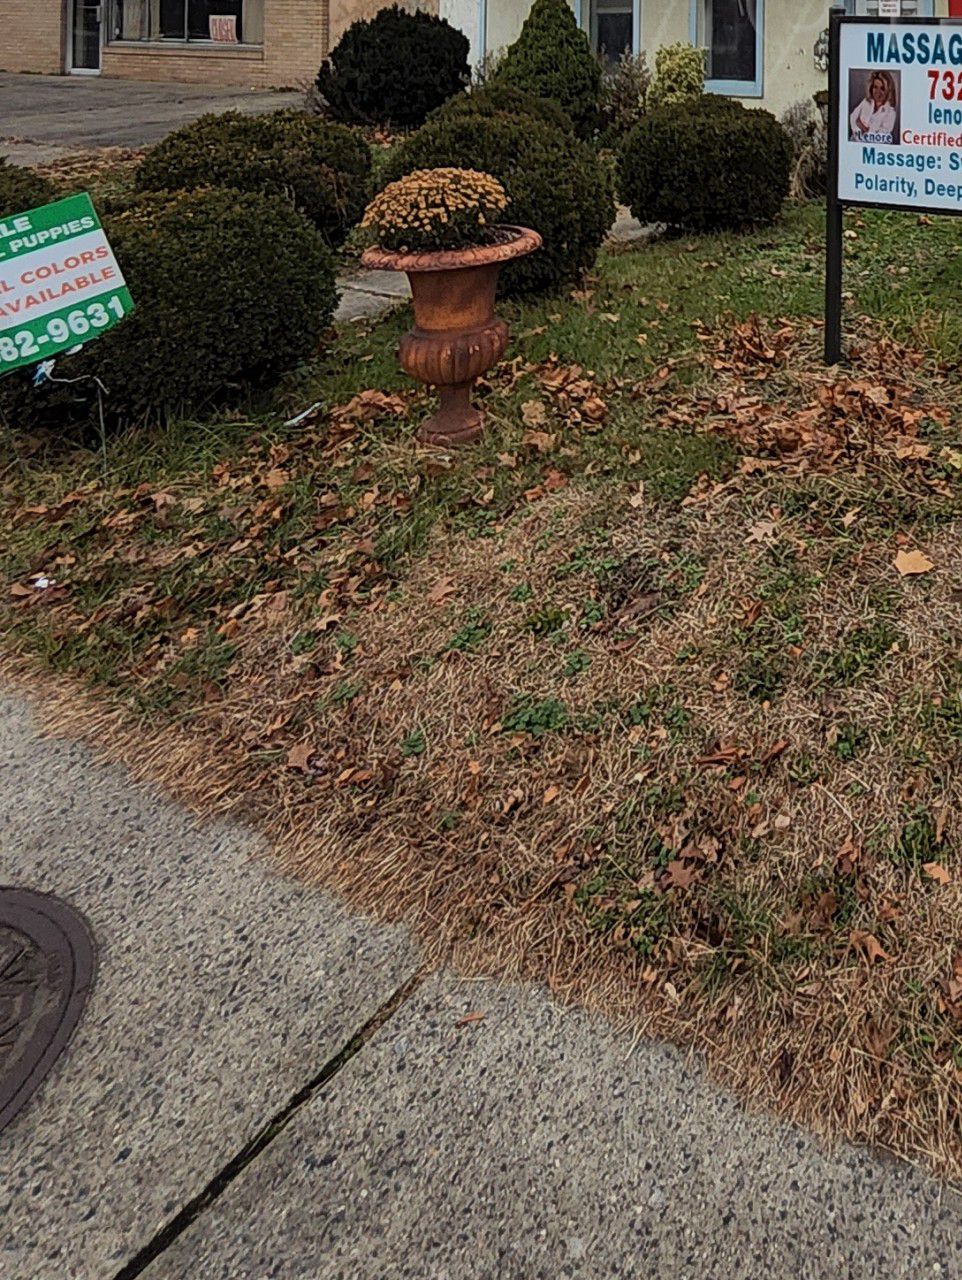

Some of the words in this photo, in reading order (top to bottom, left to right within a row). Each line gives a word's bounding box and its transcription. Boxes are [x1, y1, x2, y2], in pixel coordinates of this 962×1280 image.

[857, 129, 893, 143] Lenore
[862, 147, 942, 172] Massage:
[854, 173, 917, 197] Polarity,
[0, 216, 33, 238] LE
[9, 216, 95, 252] PUPPIES
[0, 280, 15, 294] L
[20, 245, 109, 284] COLORS
[0, 295, 125, 362] 82-9631
